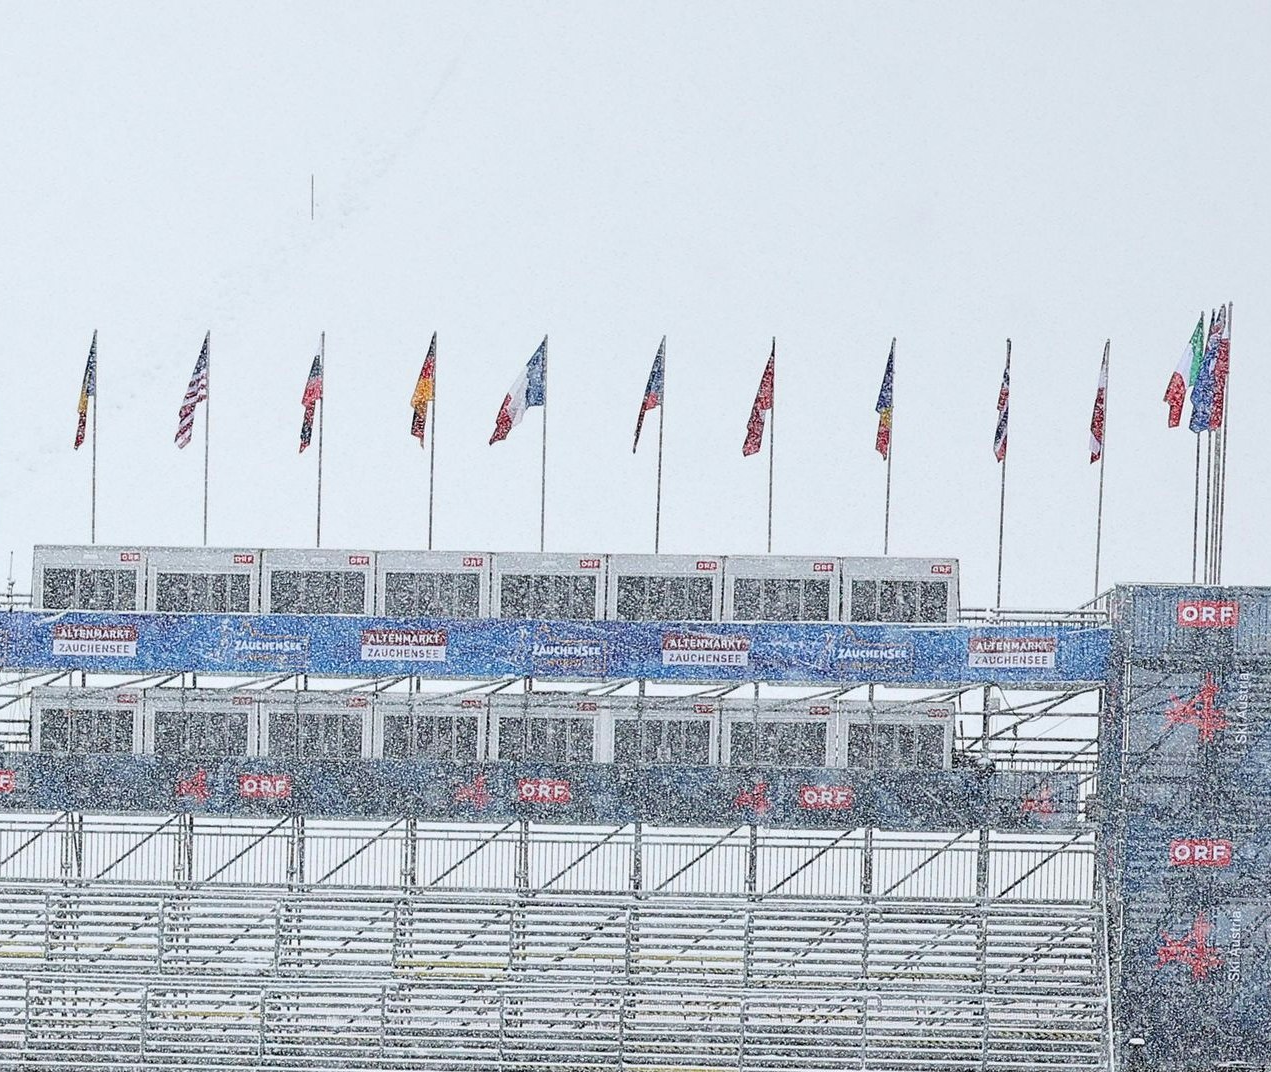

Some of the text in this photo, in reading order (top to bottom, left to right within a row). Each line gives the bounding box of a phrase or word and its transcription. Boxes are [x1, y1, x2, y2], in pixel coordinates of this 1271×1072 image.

[1182, 605, 1235, 623] ORF
[59, 628, 130, 639] ALTENMARKT
[368, 633, 441, 644] ALTENMARKT
[59, 643, 130, 653] ZAUCHENSEE
[670, 638, 742, 649] ALTENMARKT
[976, 641, 1048, 652] ALTENMARKT
[368, 648, 439, 658] ZAUCHENSEE
[669, 653, 741, 664] ZAUCHENSEE
[975, 654, 1048, 665] ZAUCHENSEE
[243, 778, 288, 793] ORF
[521, 782, 568, 799] ORF
[805, 790, 850, 806] ORF
[1175, 844, 1228, 862] ORF
[1228, 909, 1243, 981] Ski Austria
